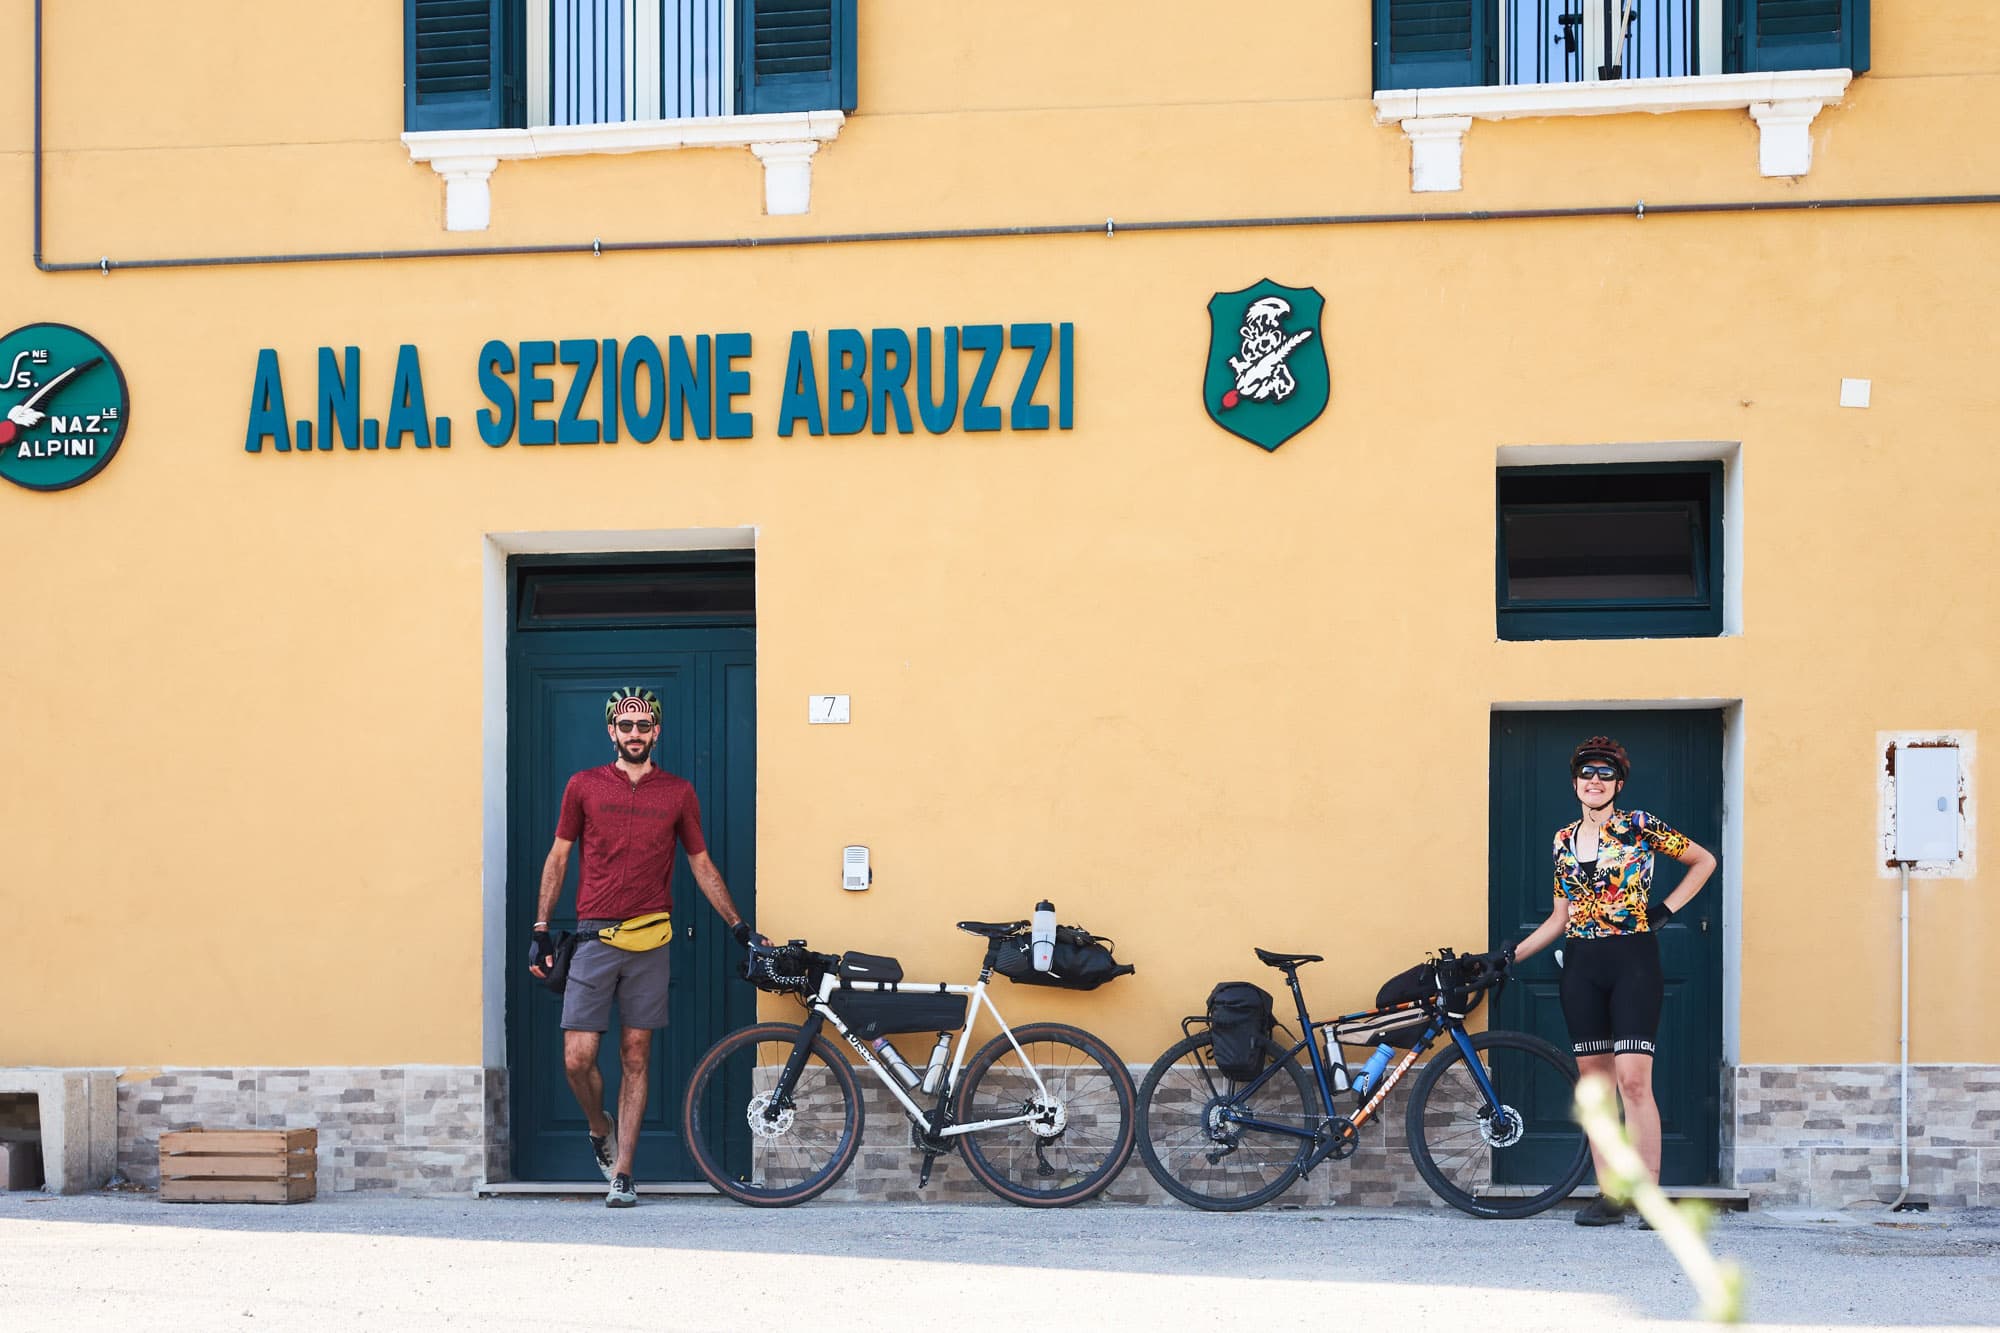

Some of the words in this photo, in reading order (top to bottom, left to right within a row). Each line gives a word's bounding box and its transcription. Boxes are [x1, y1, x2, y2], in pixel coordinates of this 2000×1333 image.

[245, 344, 451, 453] A.N.A.
[476, 333, 753, 448] SEZIONE
[778, 322, 1074, 437] ABRUZZI
[17, 438, 95, 458] ALPINI
[823, 696, 836, 718] 7
